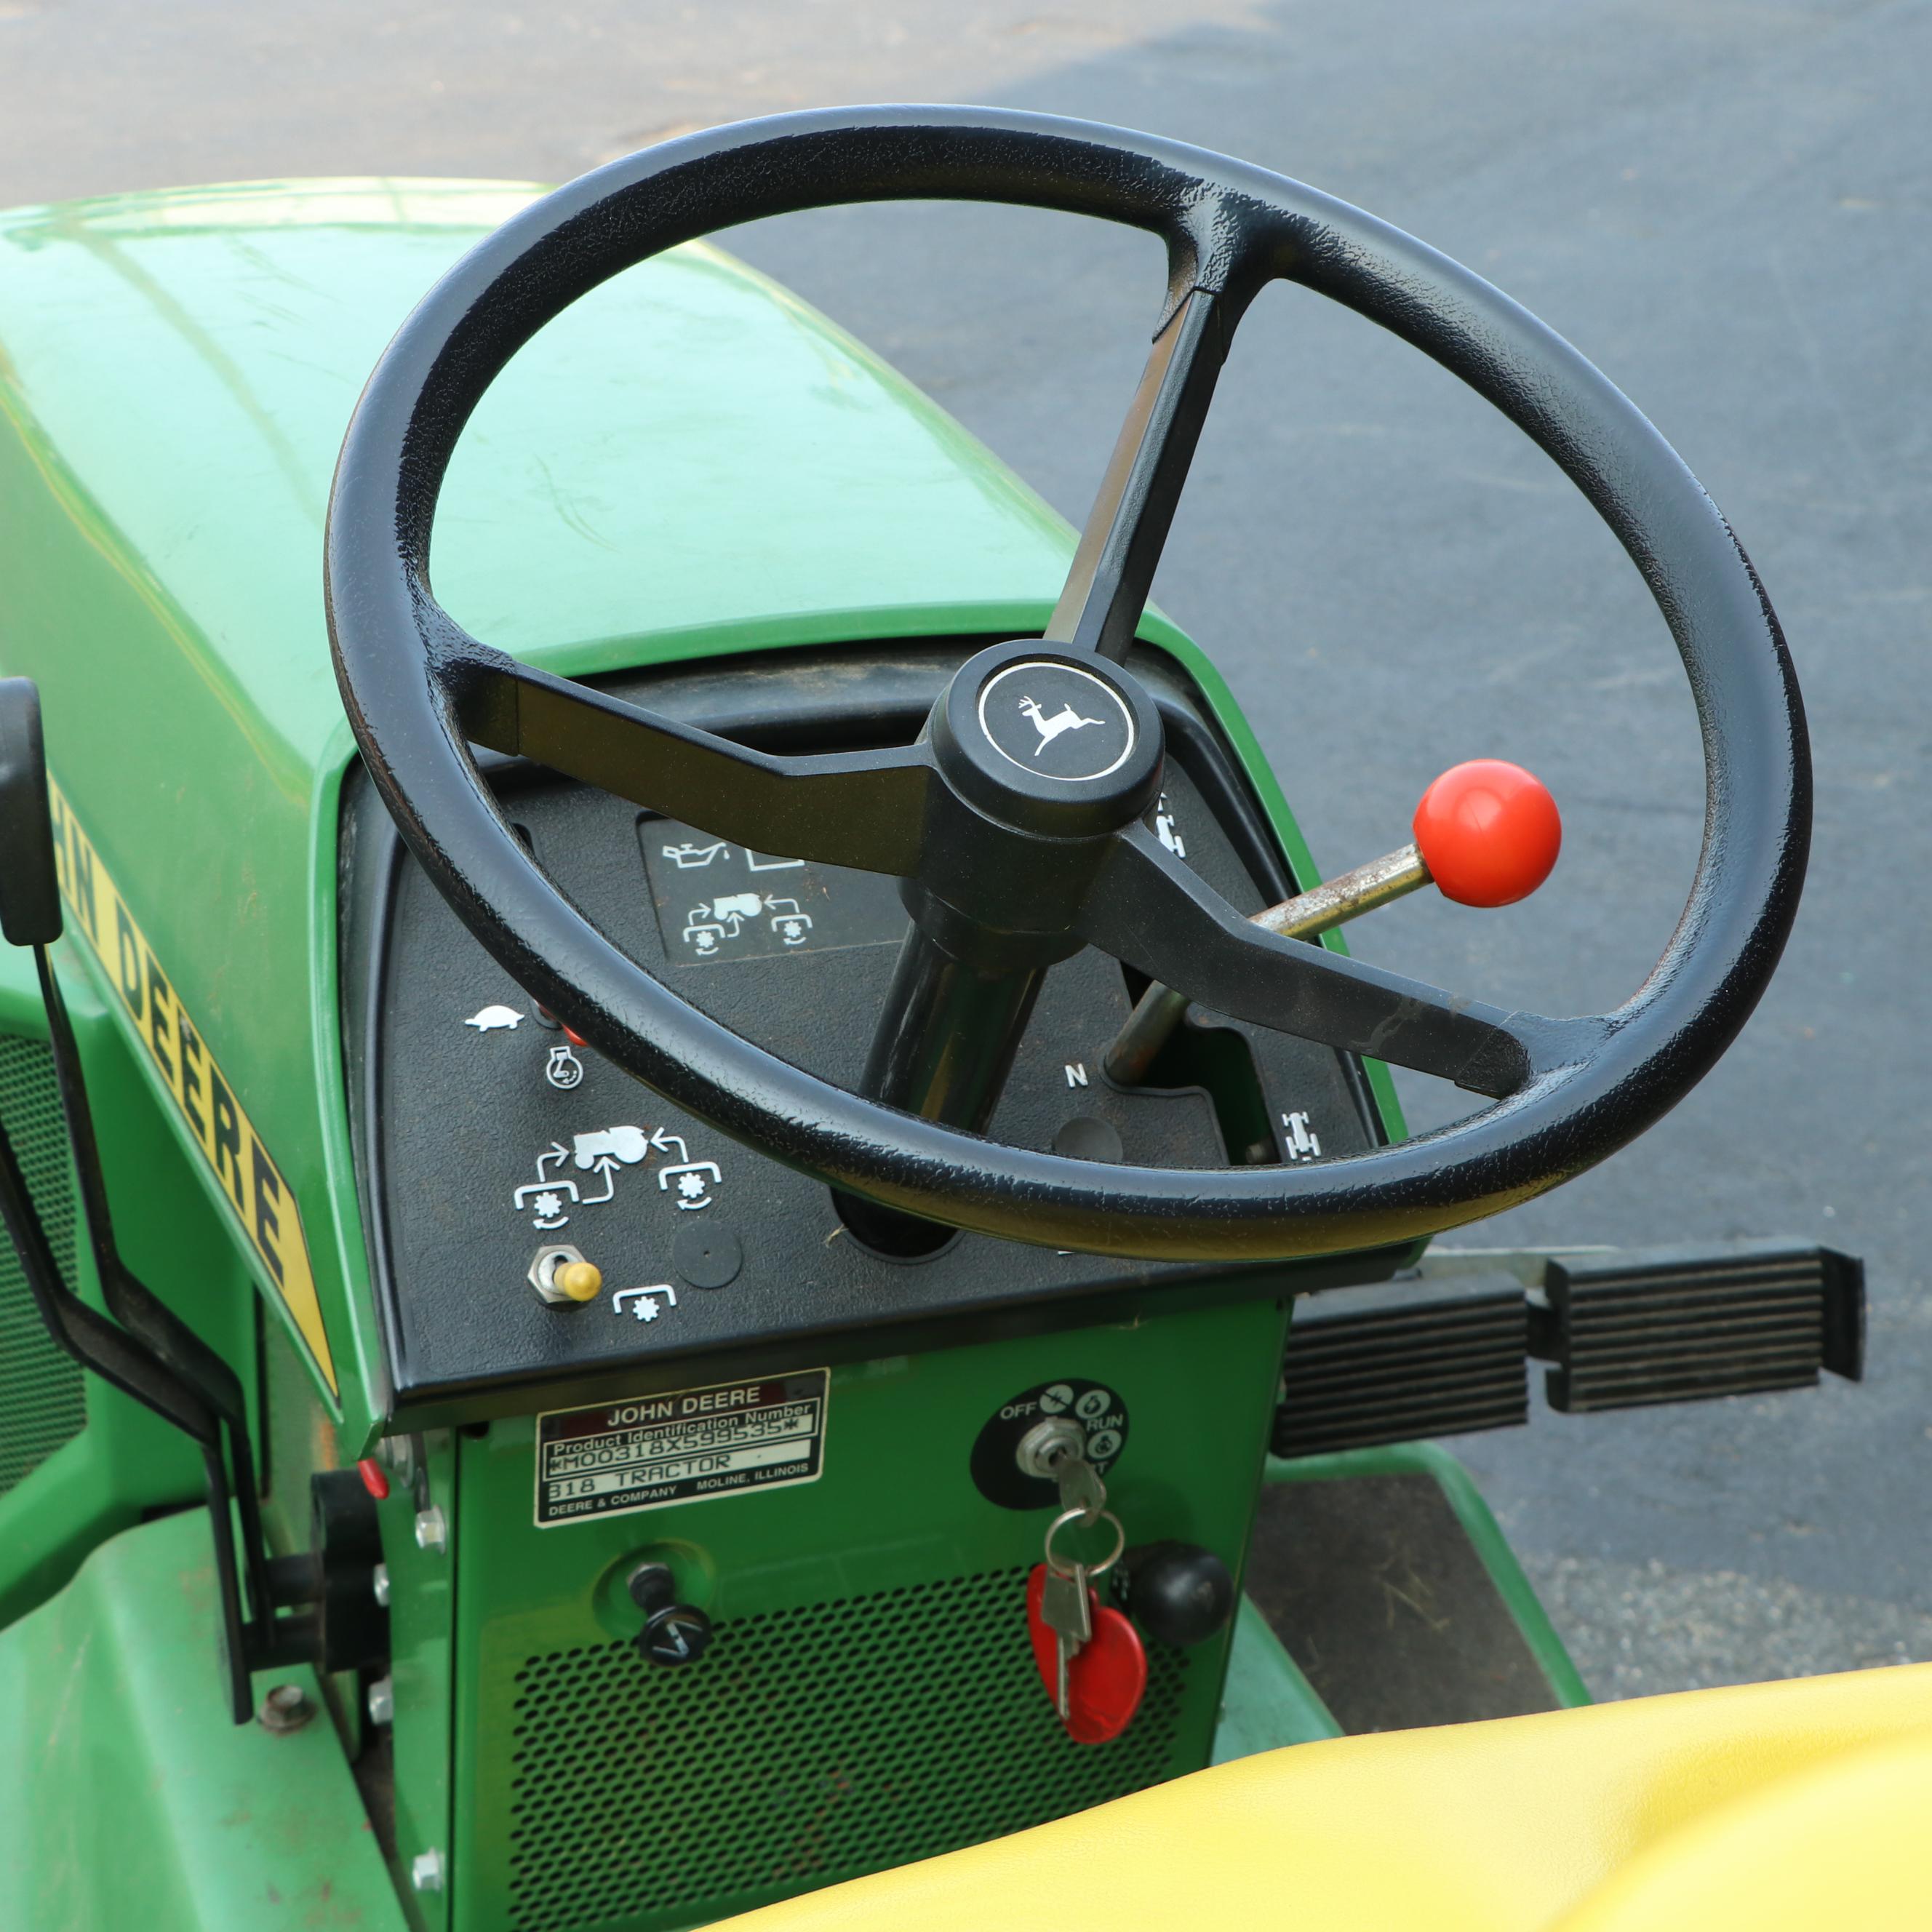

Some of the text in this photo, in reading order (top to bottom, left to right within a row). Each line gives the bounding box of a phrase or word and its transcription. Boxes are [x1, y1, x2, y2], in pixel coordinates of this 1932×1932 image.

[116, 895, 284, 1290] DEERE
[1063, 1063, 1089, 1089] N
[607, 1386, 761, 1426] JOHN DEERE
[999, 1402, 1037, 1420] OFF
[1087, 1414, 1124, 1432] RUN
[553, 1403, 811, 1456] Product Identification Number
[615, 1454, 732, 1488] TRACTOR
[548, 1463, 810, 1517] DEERE & COMPANY MOLINE, ILLINOIS
